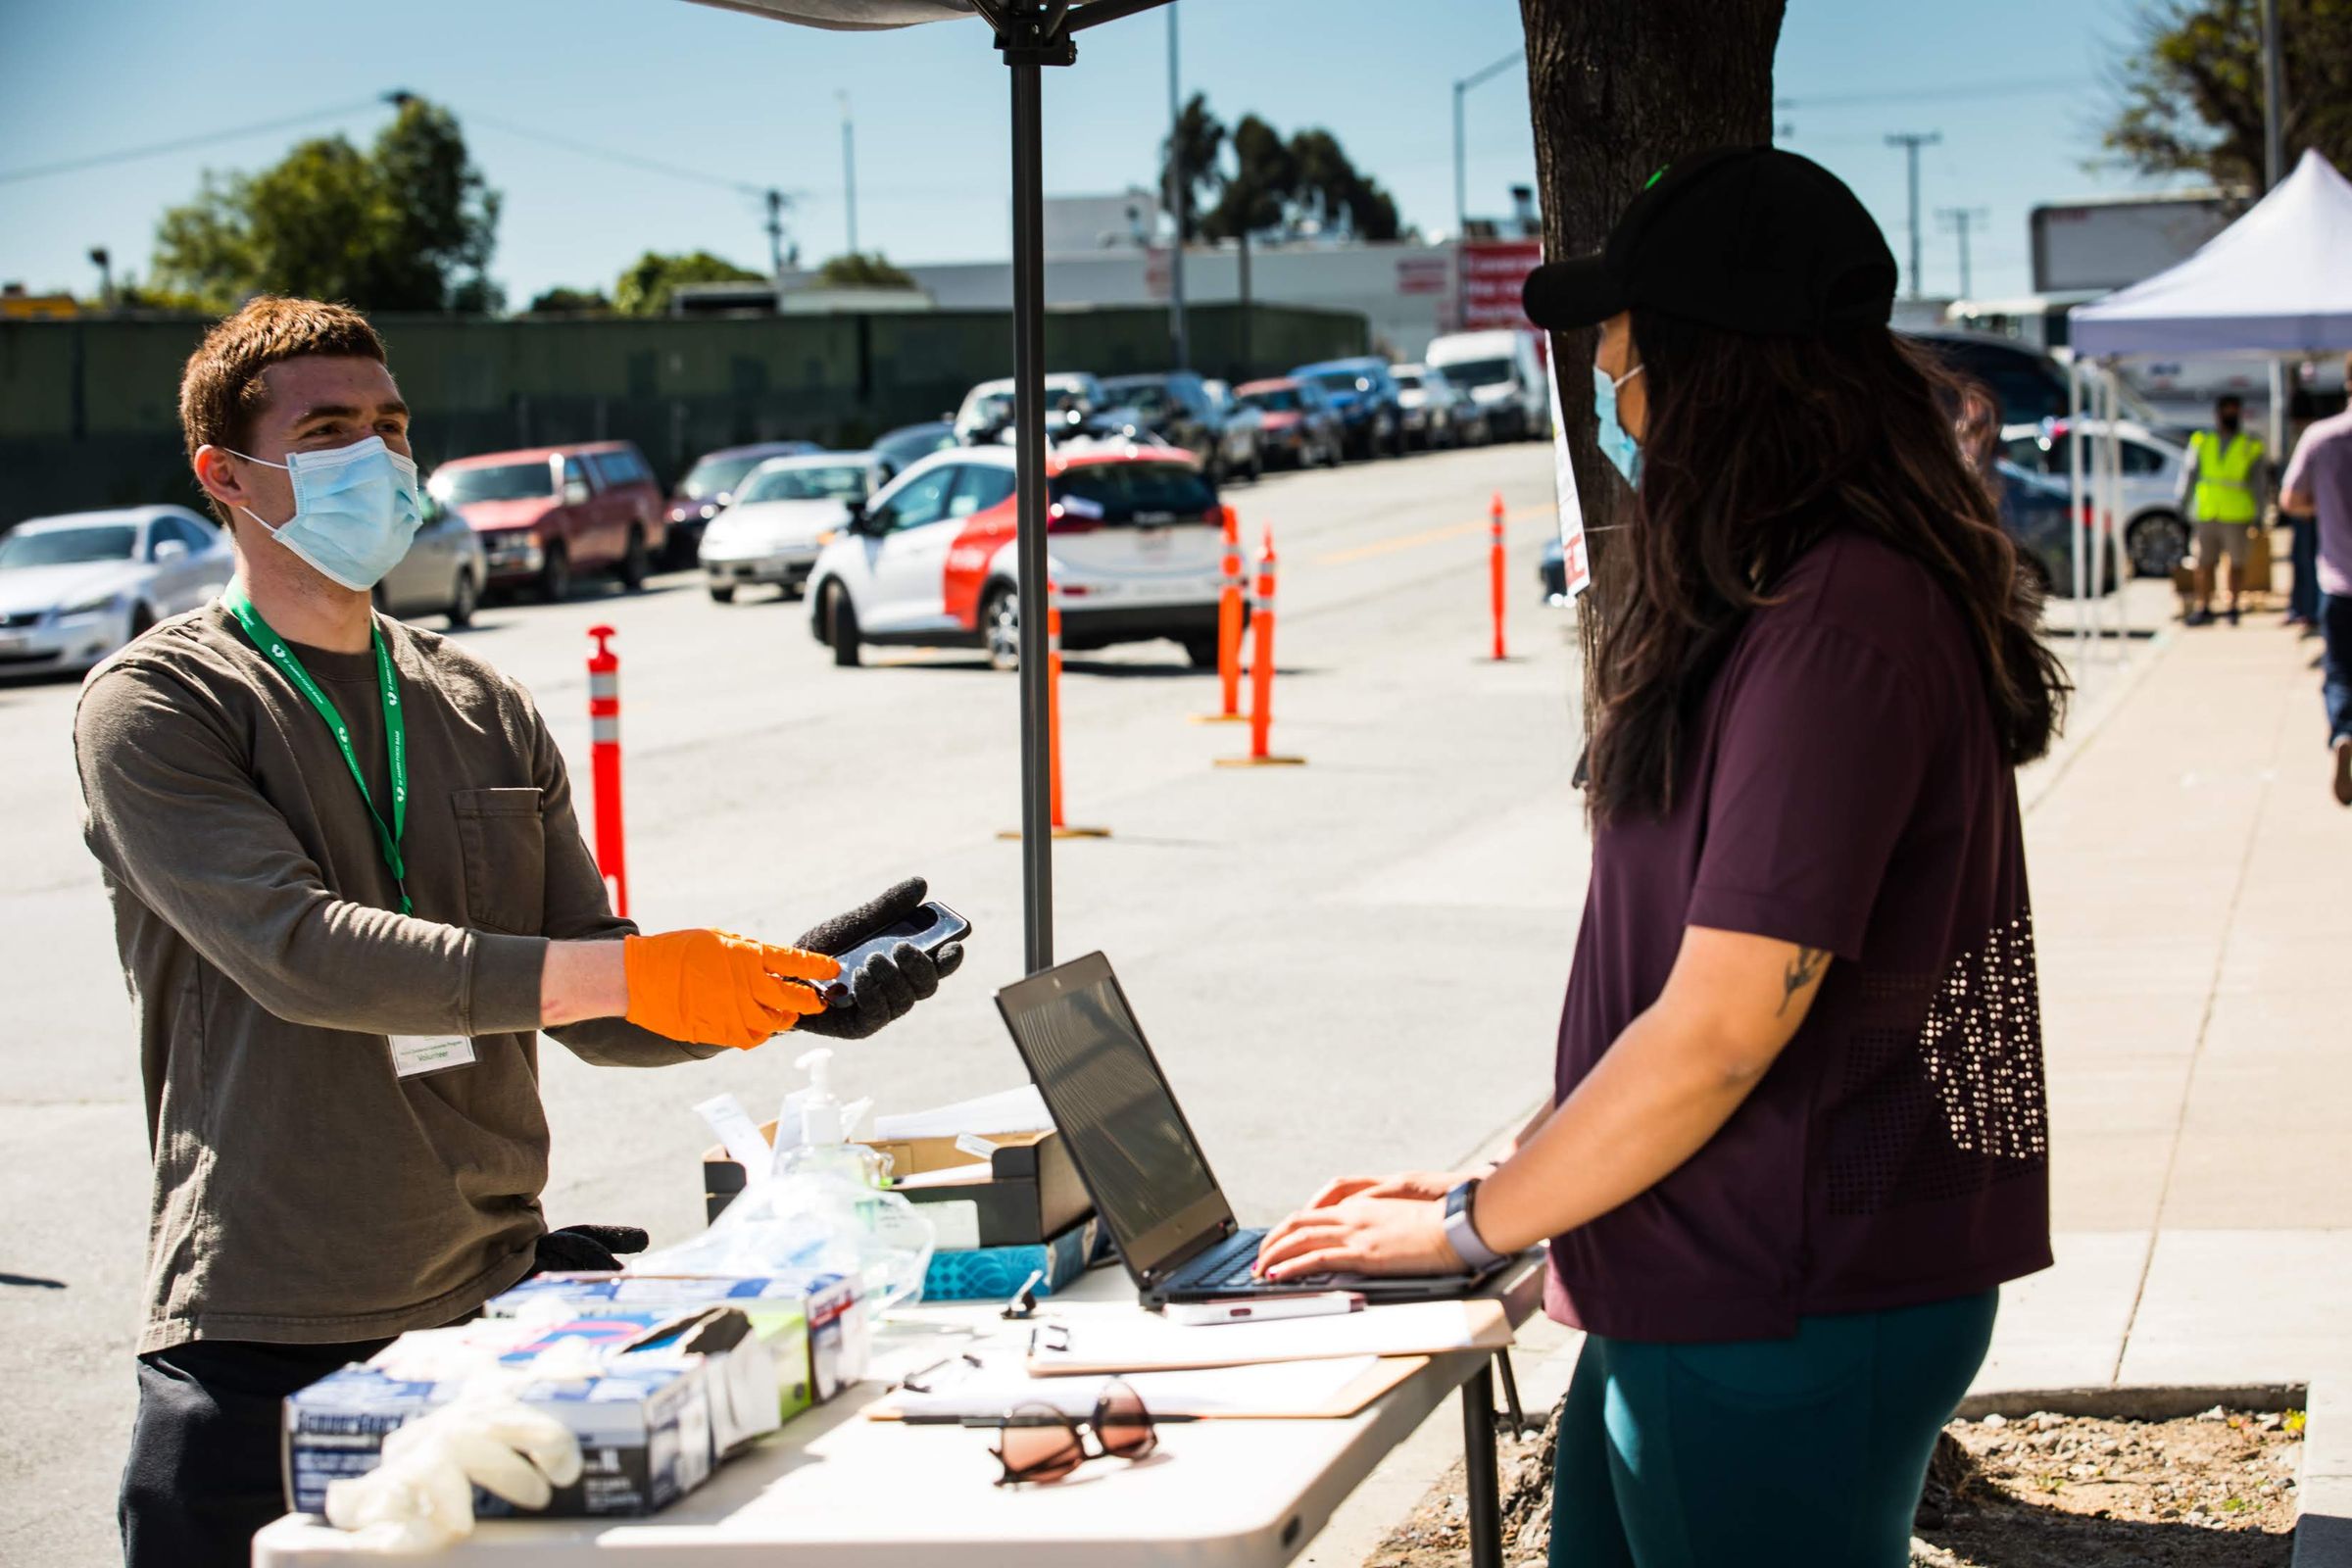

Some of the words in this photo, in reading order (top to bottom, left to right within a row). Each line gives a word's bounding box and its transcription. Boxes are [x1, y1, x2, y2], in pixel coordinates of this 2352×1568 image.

[301, 677, 315, 692] FOOD
[312, 691, 323, 704] BANK
[416, 1051, 448, 1061] Volunteer
